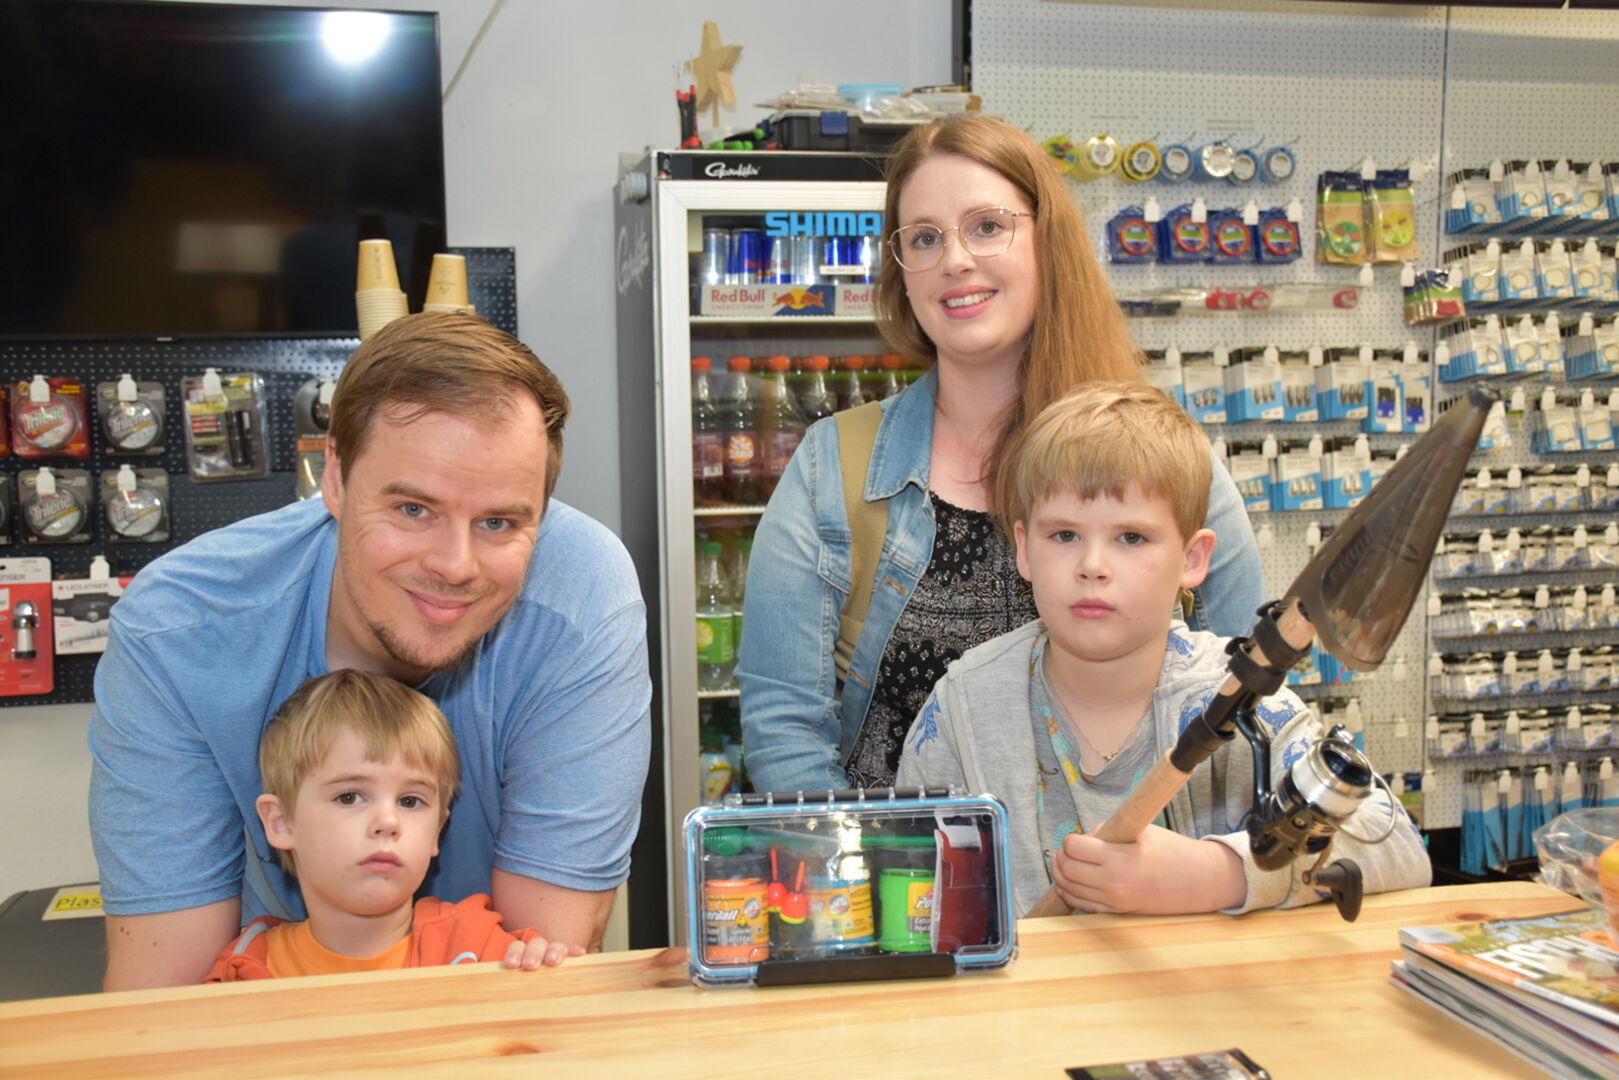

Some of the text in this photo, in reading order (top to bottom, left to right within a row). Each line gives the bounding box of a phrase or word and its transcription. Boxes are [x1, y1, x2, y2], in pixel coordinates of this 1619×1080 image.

[765, 212, 886, 236] SHIMA
[711, 289, 765, 303] Red Bull
[843, 289, 869, 303] Red
